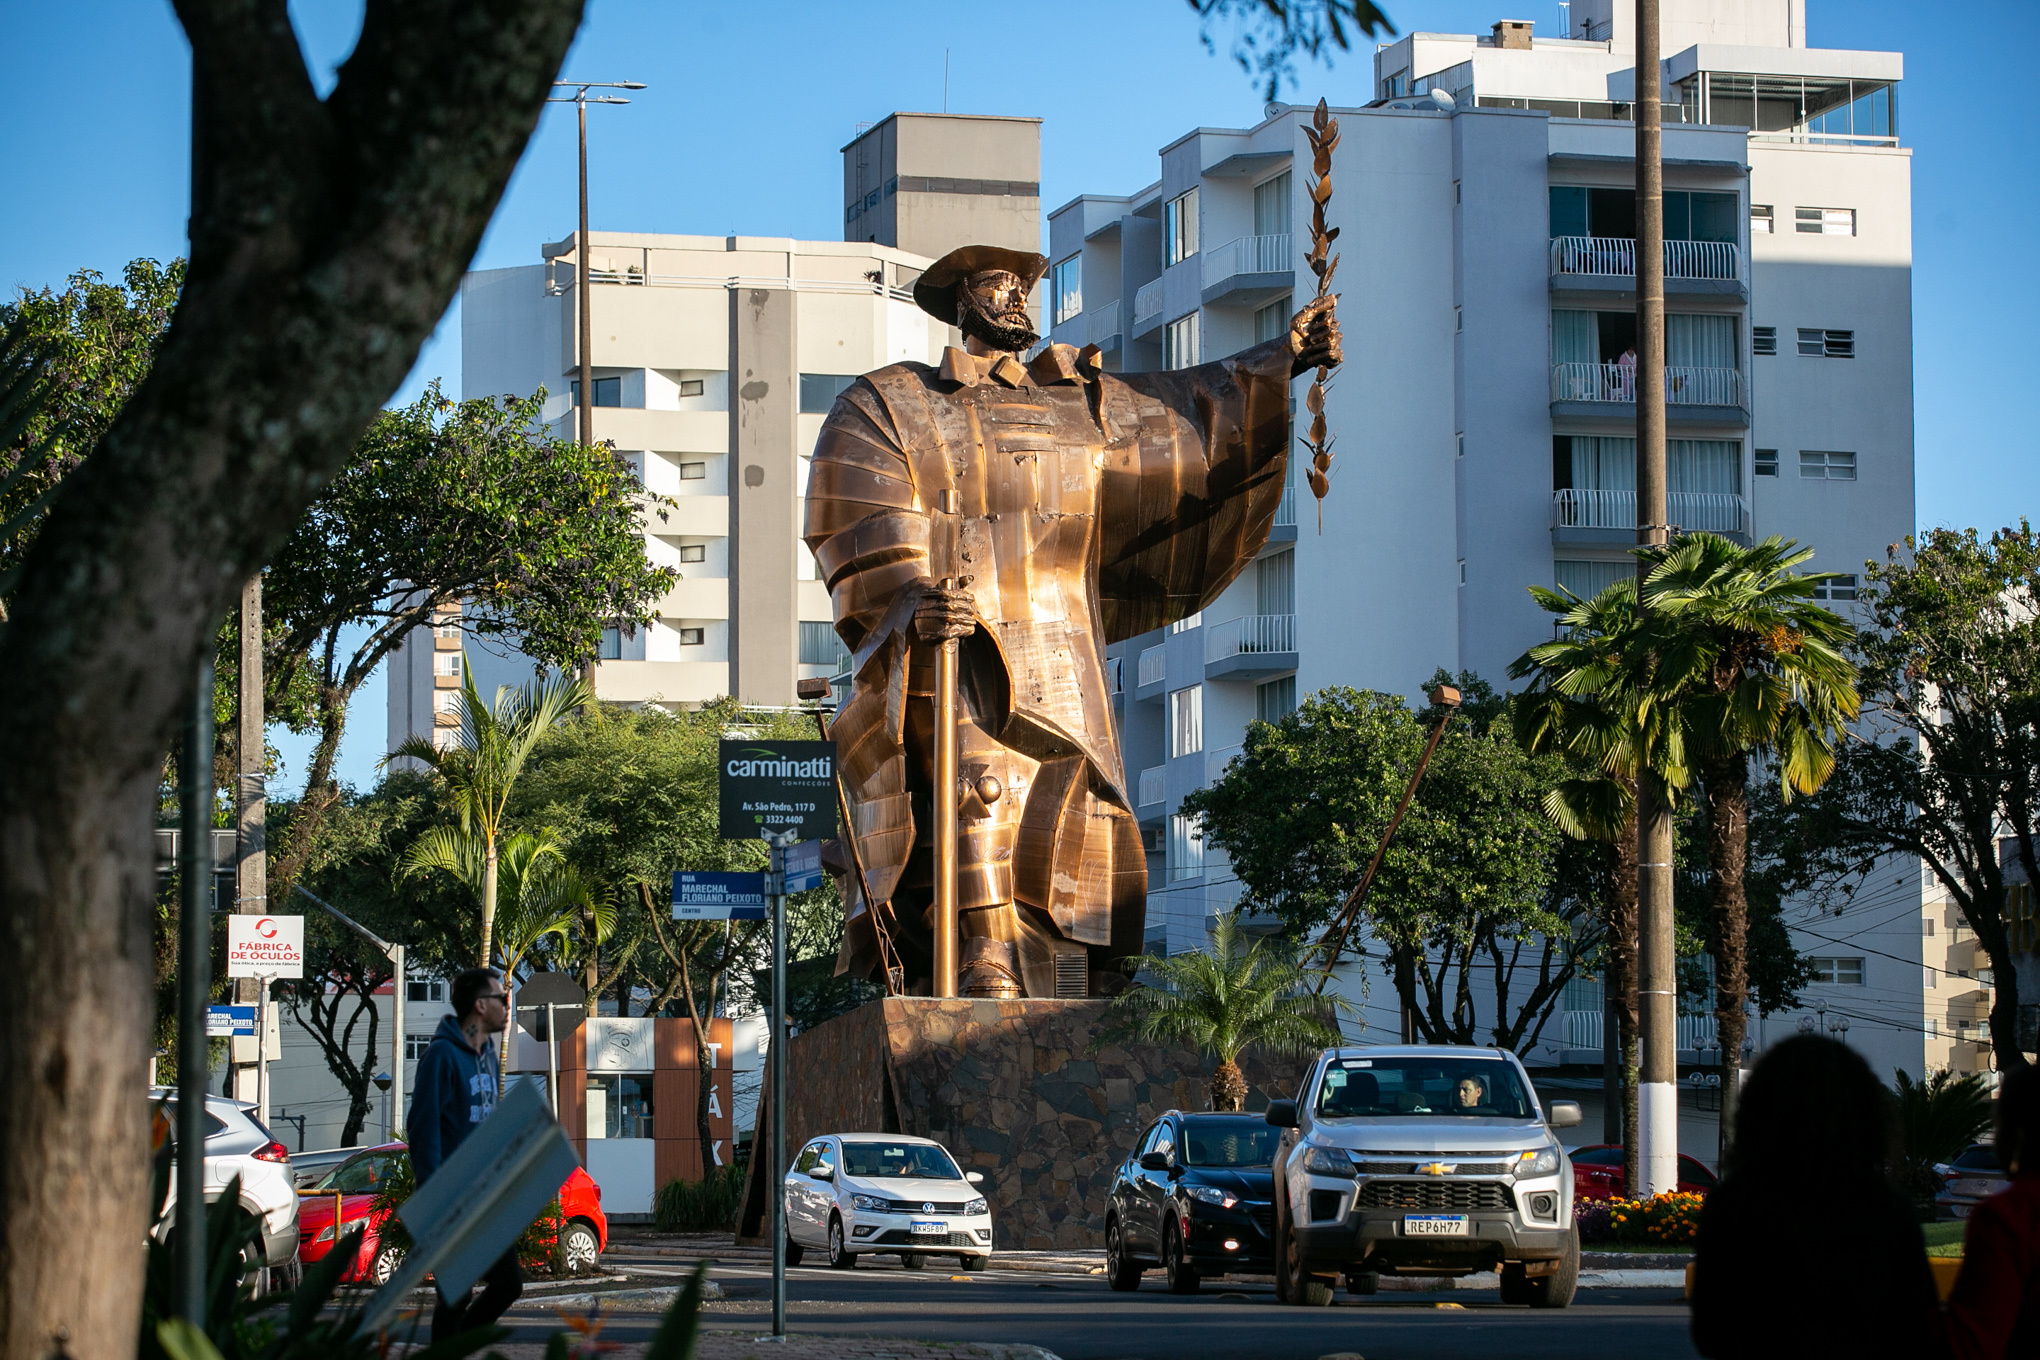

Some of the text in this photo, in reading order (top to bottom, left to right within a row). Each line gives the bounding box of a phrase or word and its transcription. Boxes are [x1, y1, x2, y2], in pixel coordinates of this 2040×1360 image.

[727, 755, 831, 778] carminatti
[742, 801, 816, 812] Av. São Pedro, 117 D
[765, 815, 804, 824] 3322 4400
[681, 884, 729, 893] MARECHAL
[681, 893, 762, 903] FLORIANO PEIXOTO
[239, 941, 292, 951] FÁBRICA
[231, 951, 301, 960] DE ÓCULOS
[1410, 1221, 1461, 1233] REP6H77
